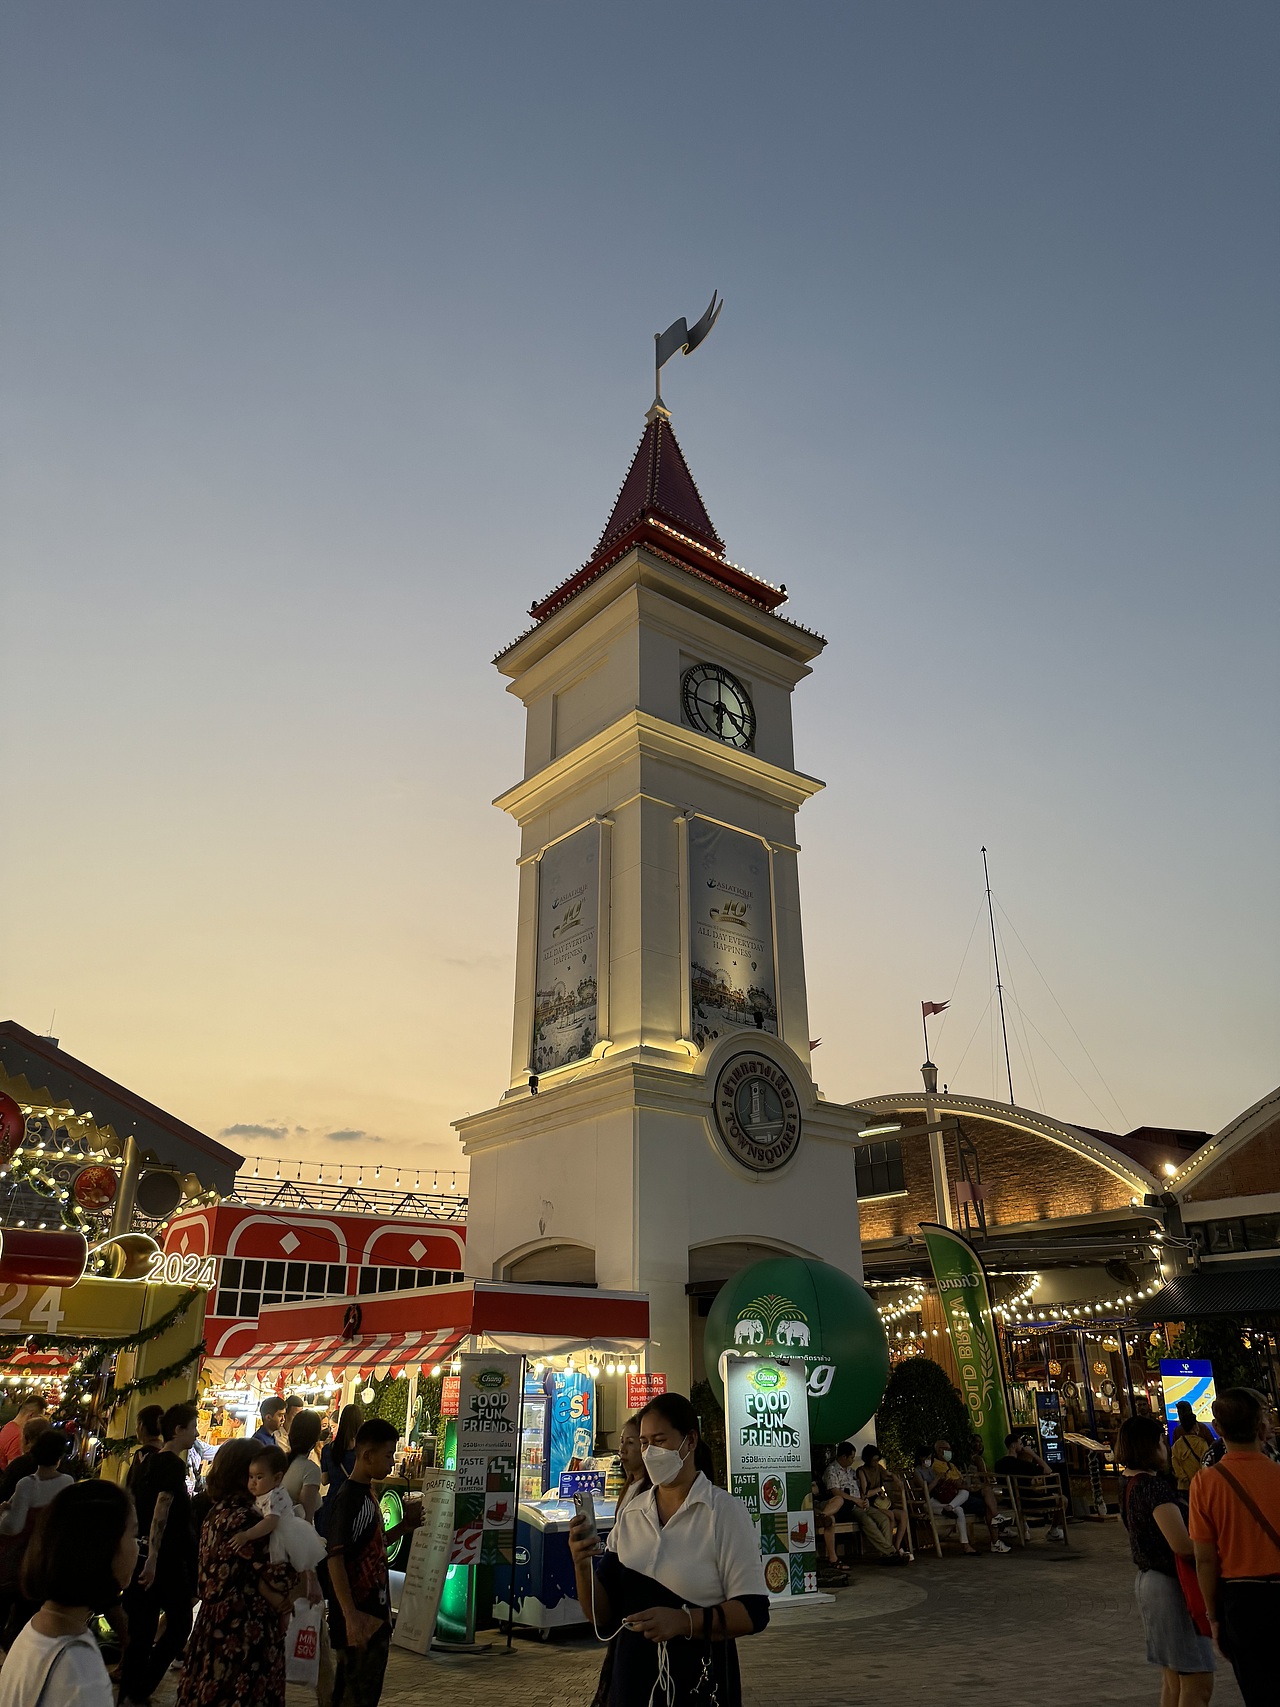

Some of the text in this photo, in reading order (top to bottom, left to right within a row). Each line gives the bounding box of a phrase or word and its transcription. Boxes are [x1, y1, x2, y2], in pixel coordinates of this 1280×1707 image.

[717, 882, 754, 899] ASIATIQUE
[543, 950, 554, 961] ALL
[553, 944, 566, 956] DAY
[564, 931, 595, 951] EVERYDAY
[698, 926, 712, 938] ALL
[713, 930, 728, 941] DAY
[728, 934, 765, 953] EVERYDAY
[553, 946, 584, 966] HAPPINESS
[713, 940, 752, 959] HAPPINESS
[146, 1251, 216, 1290] 2024
[481, 1374, 503, 1384] Chang
[758, 1372, 778, 1383] Chang
[469, 1393, 510, 1409] FOOD
[555, 1391, 590, 1424] est
[744, 1390, 791, 1413] FOOD
[478, 1408, 502, 1420] FUN
[757, 1413, 784, 1429] FUN
[462, 1419, 516, 1434] FRIENDS
[740, 1427, 801, 1449] FRIENDS
[459, 1457, 485, 1466] TASTE
[459, 1467, 468, 1475] OF
[426, 1479, 446, 1491] DRAFT
[459, 1476, 484, 1486] THAI
[734, 1474, 757, 1485] TASTE
[734, 1486, 743, 1494] OF
